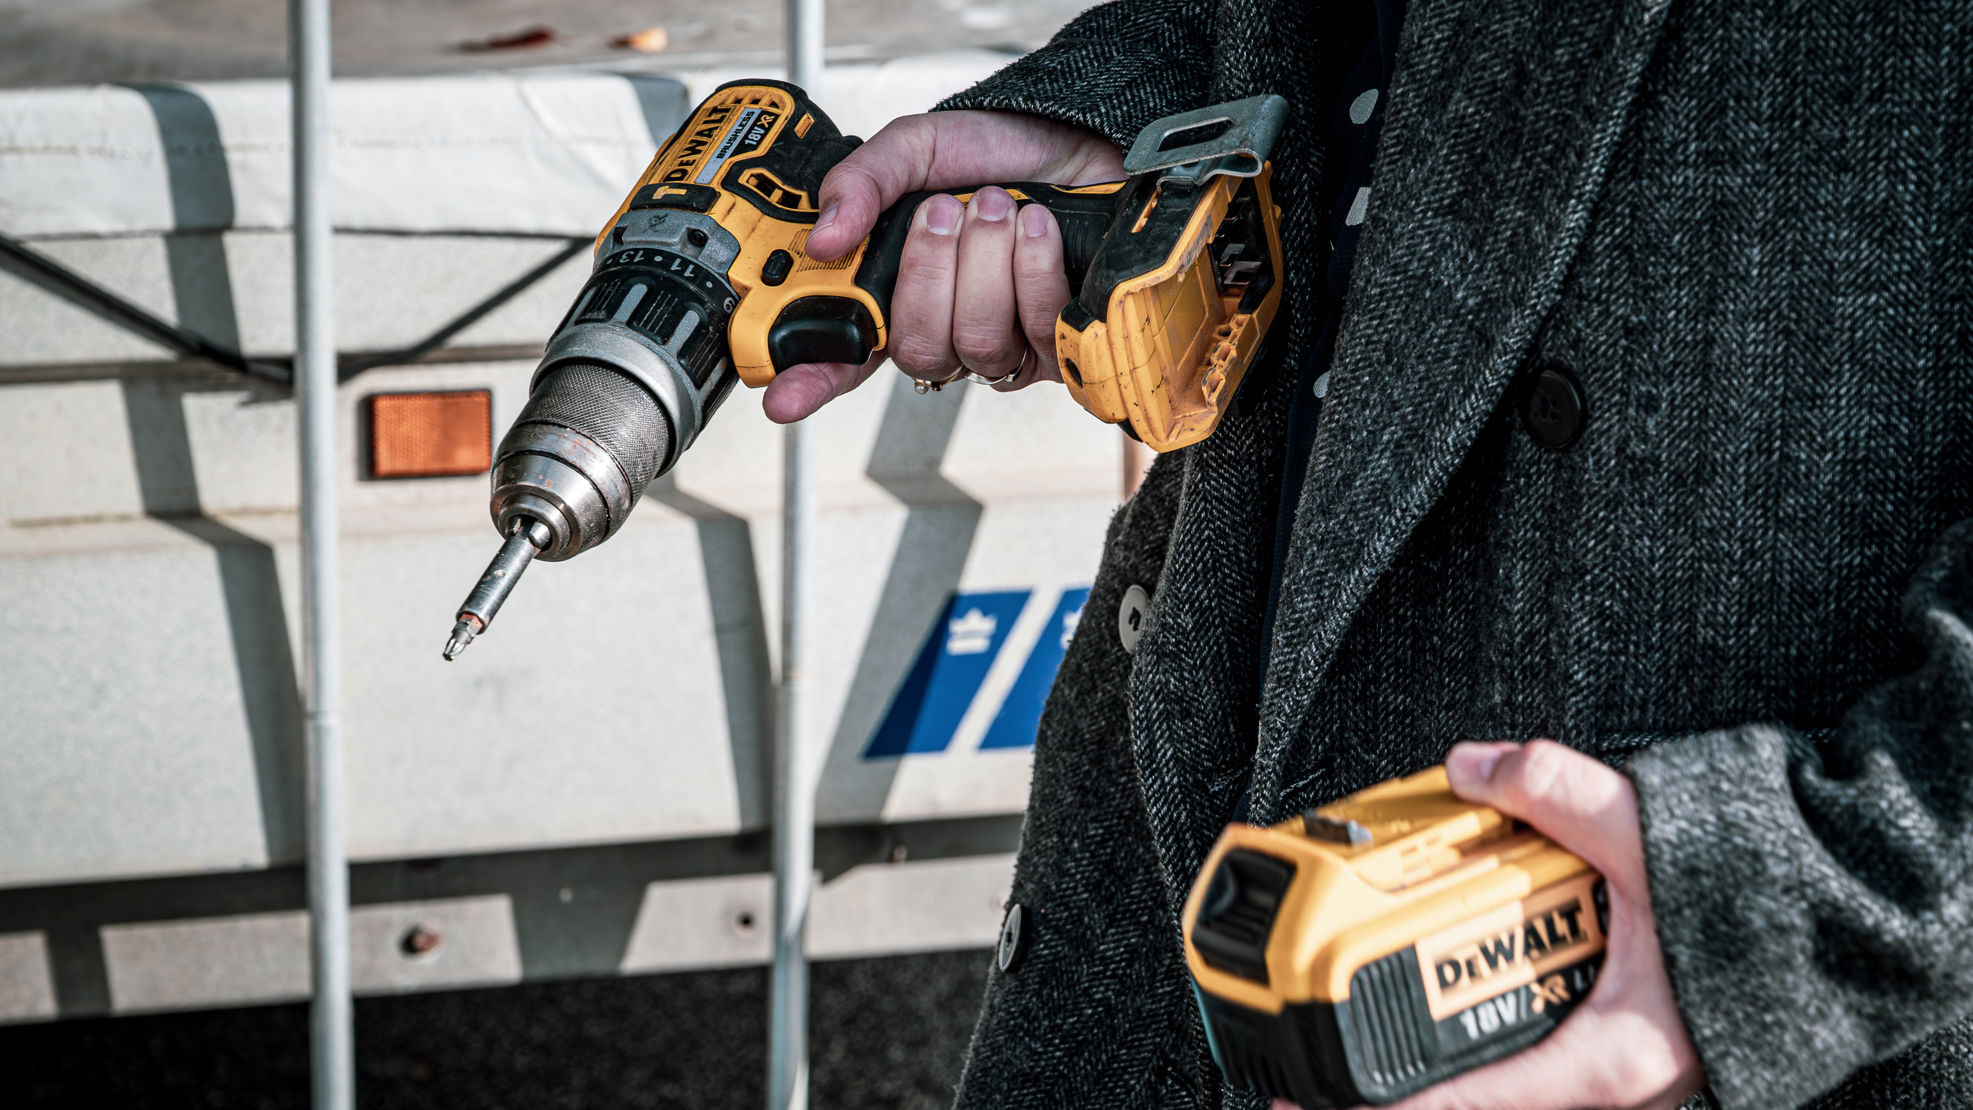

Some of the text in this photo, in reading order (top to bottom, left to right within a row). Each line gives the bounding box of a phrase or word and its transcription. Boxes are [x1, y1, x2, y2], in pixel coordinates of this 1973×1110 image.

[663, 106, 732, 182] DEWALT
[716, 111, 755, 159] BRUSHLESS
[745, 114, 775, 146] 18V XR
[619, 250, 645, 263] 13
[670, 257, 695, 277] 11
